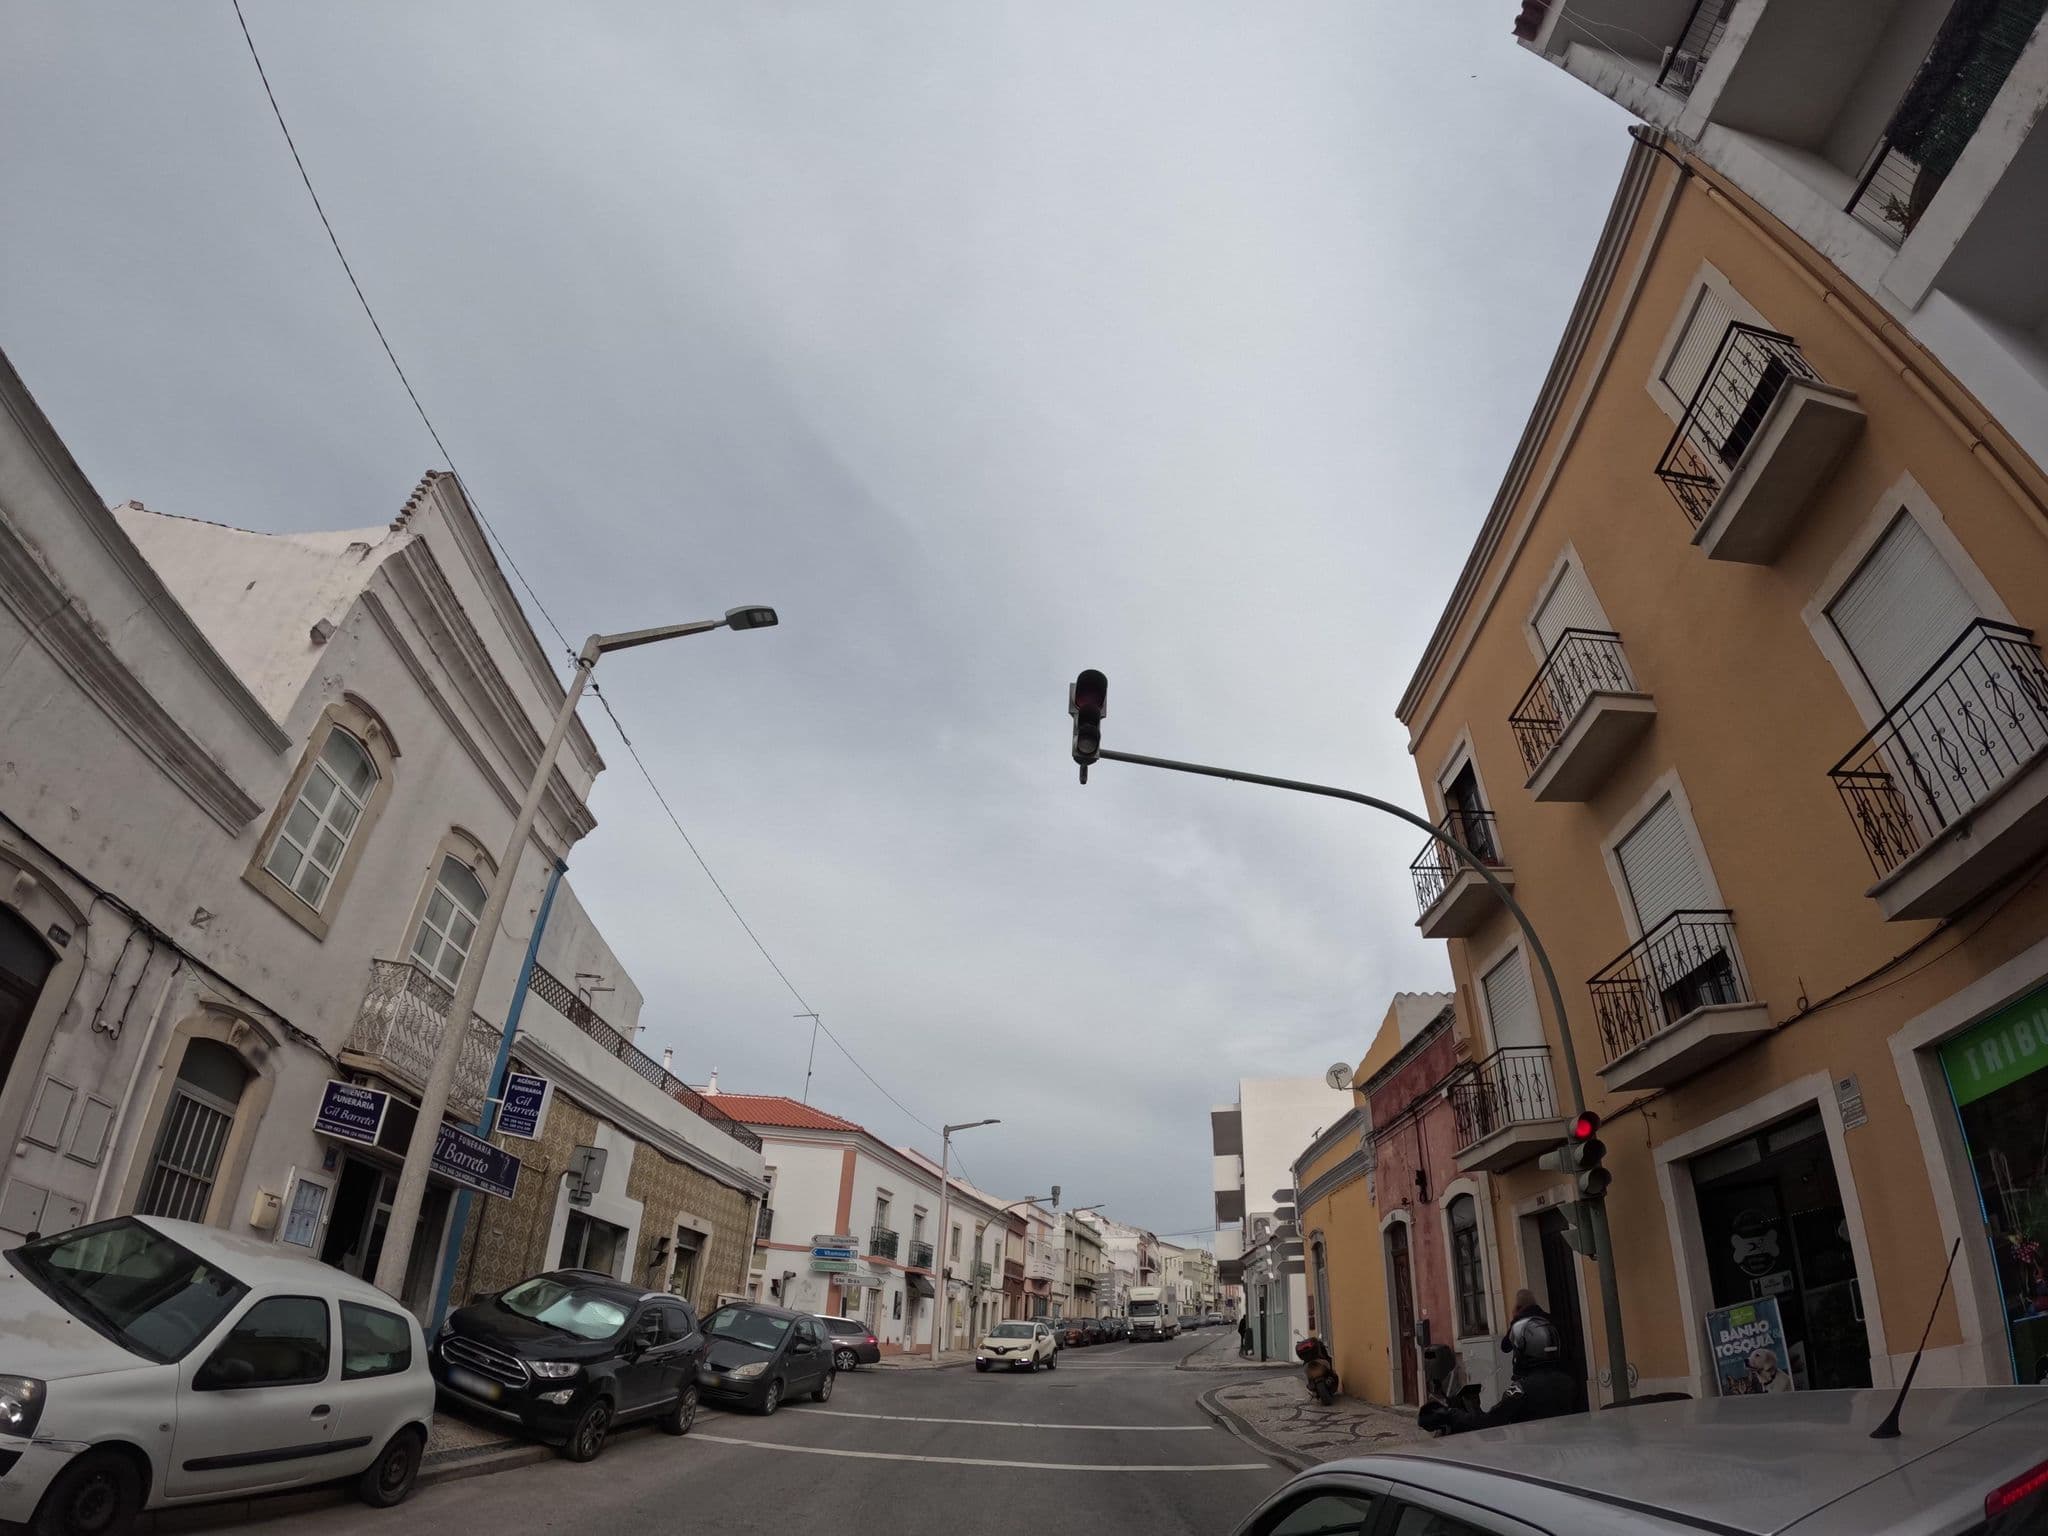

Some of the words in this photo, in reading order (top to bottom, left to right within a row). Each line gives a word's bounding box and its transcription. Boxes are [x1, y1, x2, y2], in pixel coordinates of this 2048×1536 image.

[503, 1102, 539, 1117] Barreto
[515, 1095, 533, 1107] Gil
[324, 1105, 341, 1117] Gil
[340, 1109, 375, 1126] Barreto
[444, 1142, 489, 1174] Barreto
[1719, 1320, 1769, 1343] BANHO
[1715, 1334, 1775, 1359] TOSQUIA
